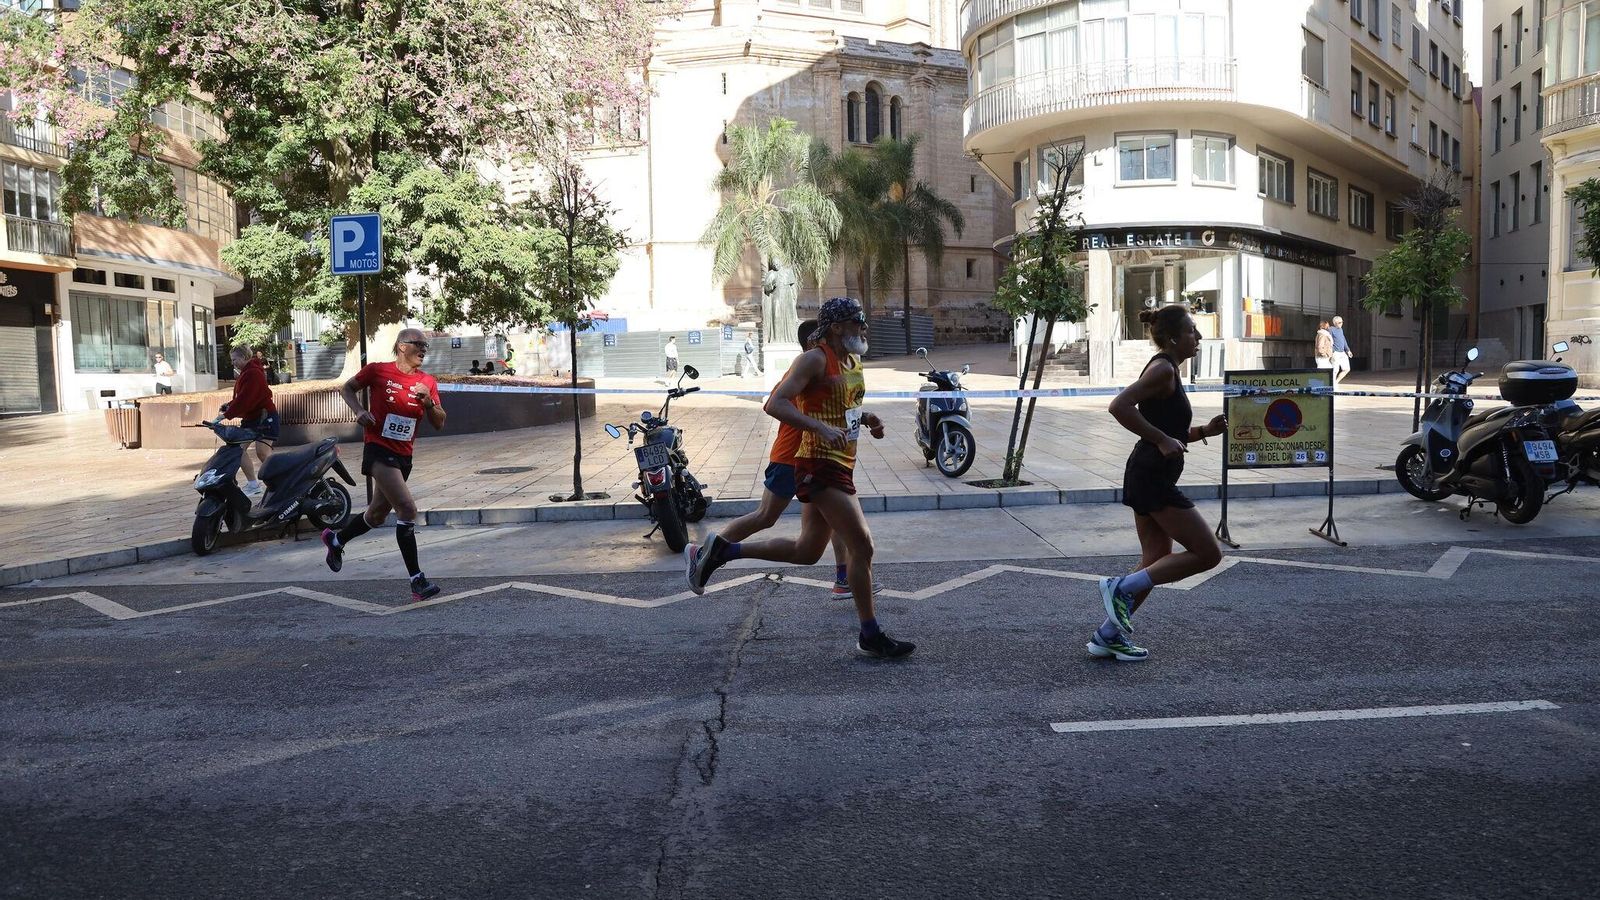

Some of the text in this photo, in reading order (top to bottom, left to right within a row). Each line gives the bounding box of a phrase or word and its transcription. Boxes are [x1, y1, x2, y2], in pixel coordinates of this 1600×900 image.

[334, 221, 365, 267] P
[1082, 233, 1182, 250] REAL ESTATE
[350, 258, 378, 269] MOTOS
[1271, 379, 1300, 387] LOCAL
[388, 422, 411, 434] 882
[1230, 441, 1326, 452] PROHIBIDO ESTACIONAR DESDE
[648, 454, 665, 466] LCD
[1230, 453, 1242, 462] LAS
[1268, 453, 1280, 461] DEL
[1534, 450, 1551, 459] MSB
